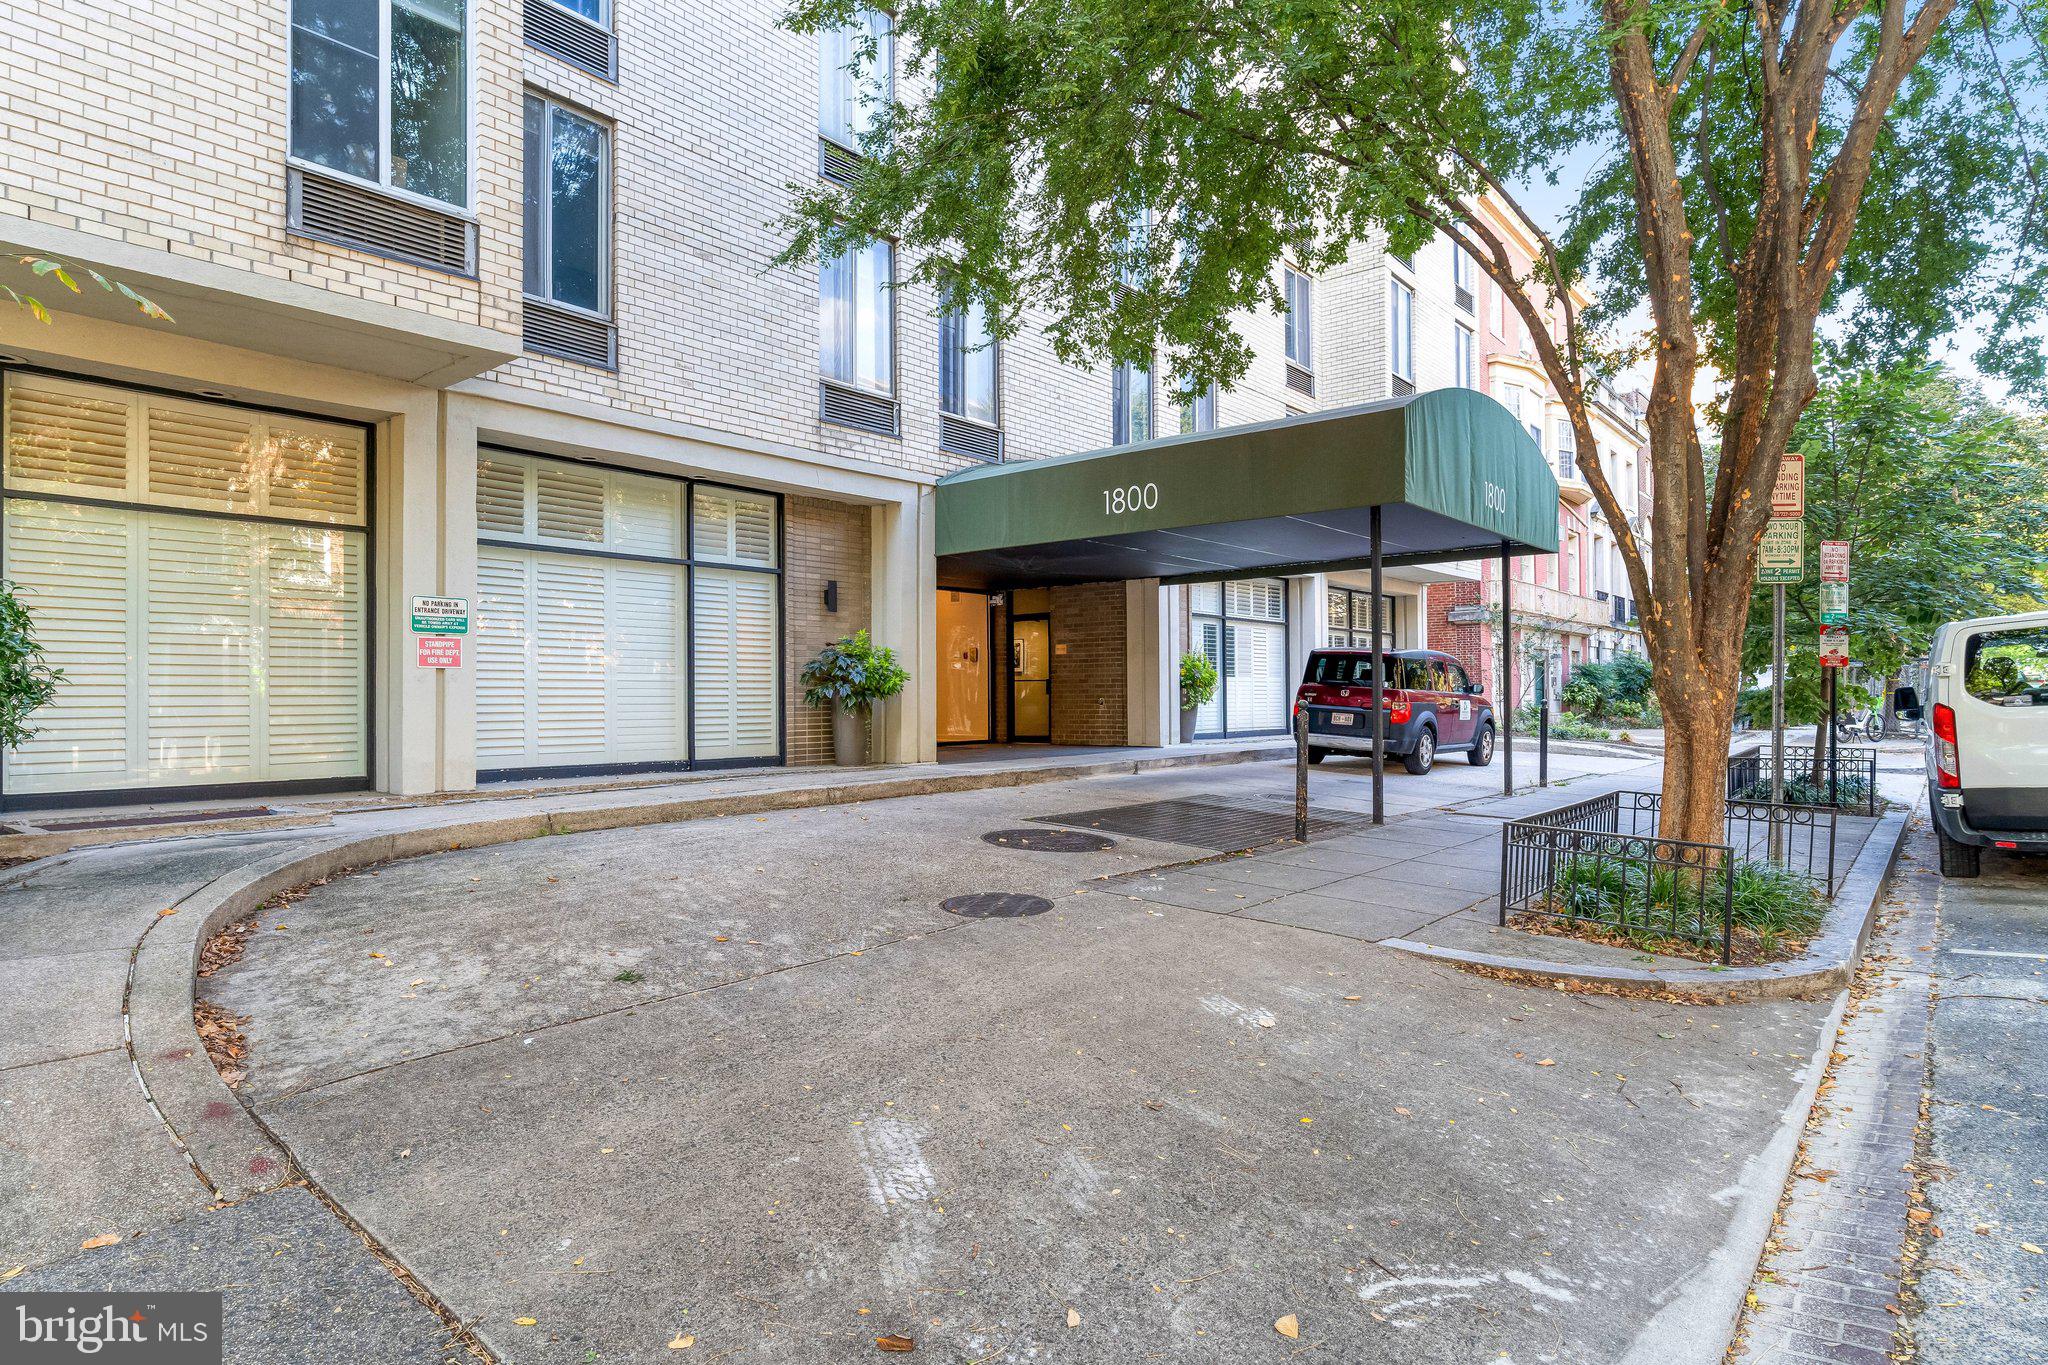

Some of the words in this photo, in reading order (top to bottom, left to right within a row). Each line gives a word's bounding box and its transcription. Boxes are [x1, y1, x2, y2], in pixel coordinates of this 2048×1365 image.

[1775, 482, 1800, 491] ARKING
[1103, 482, 1159, 515] 1800
[1484, 481, 1506, 514] 1800
[1779, 522, 1799, 530] HOUR
[1763, 531, 1799, 539] PARKING
[1762, 545, 1800, 554] 7AM-8:30PM
[1774, 567, 1781, 576] 2
[431, 600, 452, 608] PARKING
[414, 606, 440, 614] ENTRANCE
[441, 608, 466, 616] DRIVEWAY
[425, 640, 455, 648] STANDPIPE
[419, 648, 431, 656] FOR
[431, 648, 445, 656] FIRE
[427, 656, 440, 664] USE
